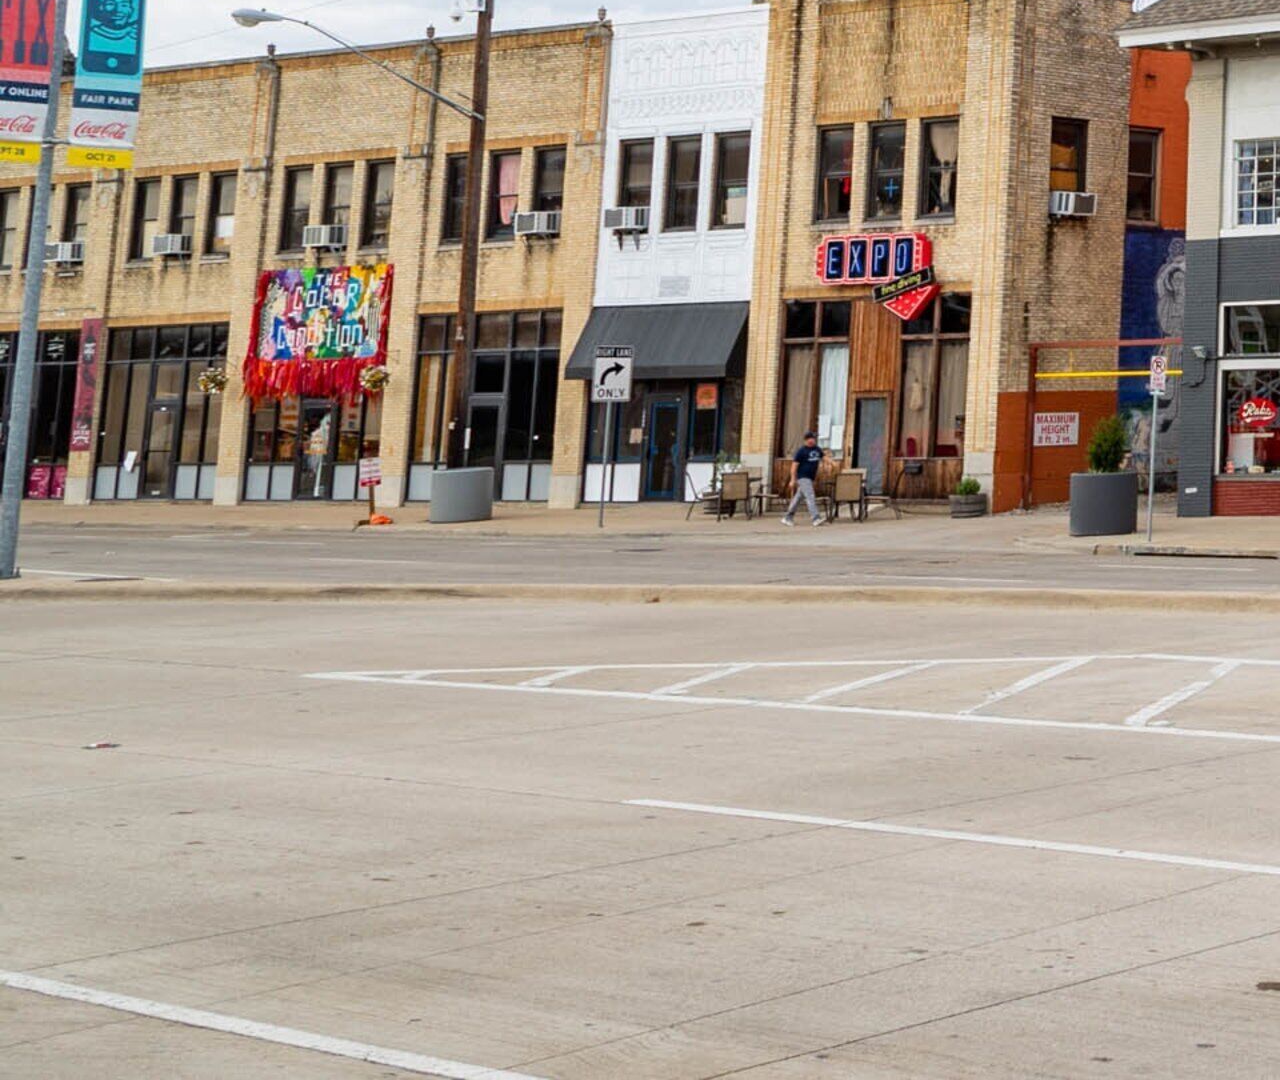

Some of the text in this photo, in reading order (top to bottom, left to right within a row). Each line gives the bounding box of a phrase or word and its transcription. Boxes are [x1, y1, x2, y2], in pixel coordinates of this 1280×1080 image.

[8, 88, 48, 99] ONLINE
[81, 93, 135, 107] FAIR PARK
[74, 120, 128, 139] Coca-Cola
[14, 148, 25, 157] 28
[86, 152, 116, 162] OCT 21
[828, 242, 907, 274] EXPO
[315, 272, 344, 286] THE
[596, 348, 632, 357] RIGHT LANE
[597, 388, 625, 398] ONLY
[1036, 413, 1076, 424] MAXIMUM
[1041, 425, 1071, 435] HEIGHT
[1055, 436, 1061, 445] 2
